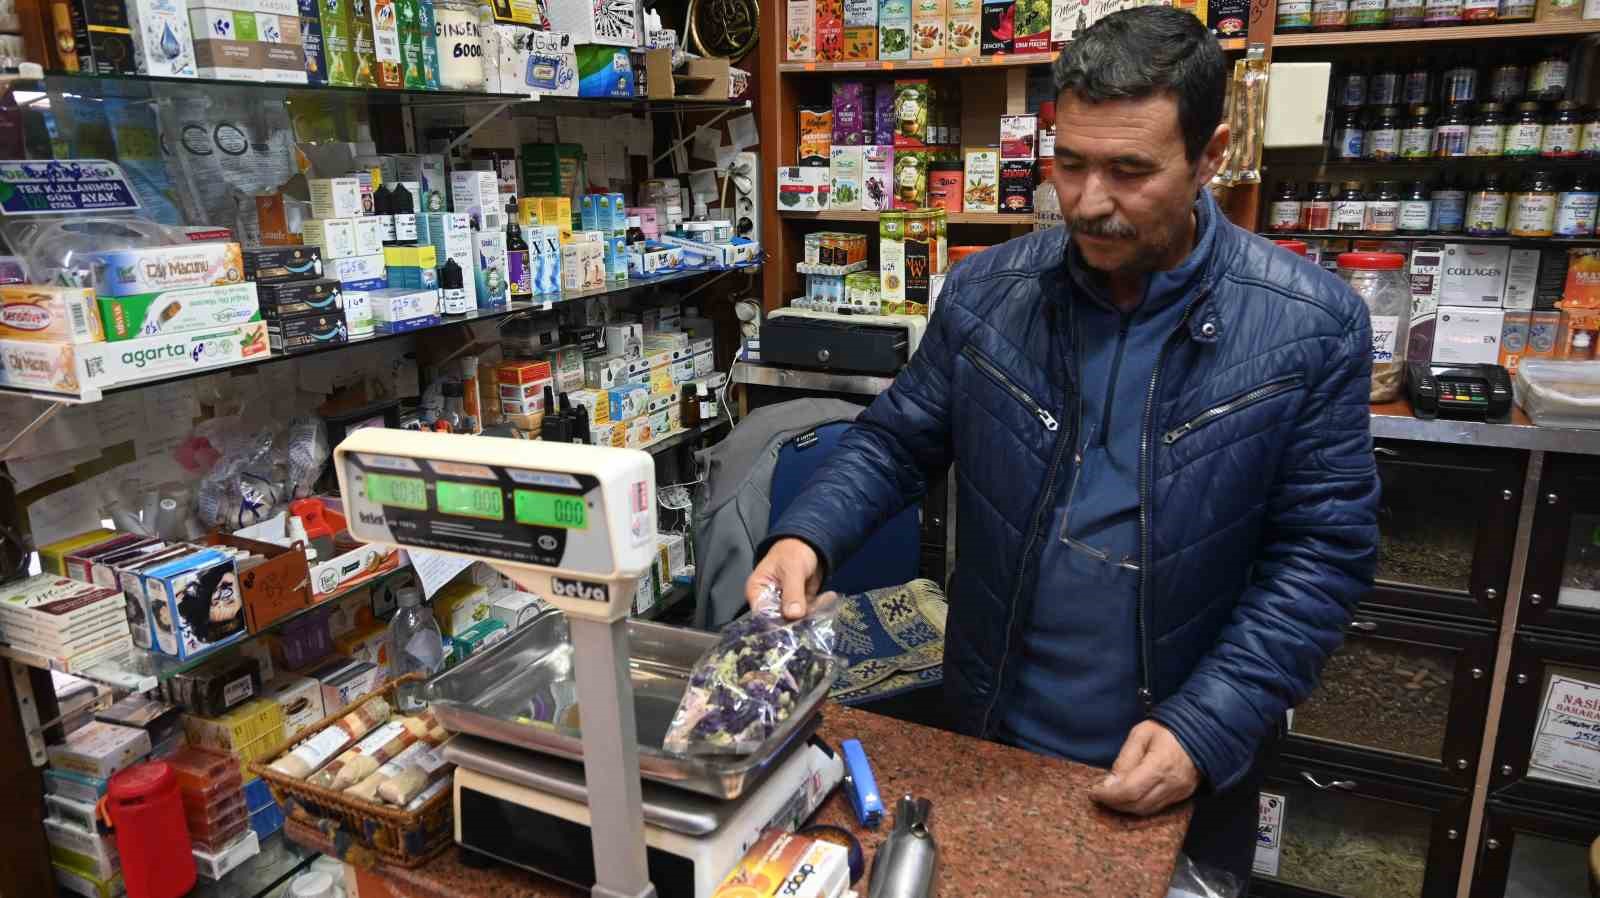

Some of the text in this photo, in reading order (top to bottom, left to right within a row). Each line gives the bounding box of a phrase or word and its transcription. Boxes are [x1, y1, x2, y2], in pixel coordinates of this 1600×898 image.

[17, 185, 43, 193] TEK
[80, 191, 117, 204] AYAK
[1446, 267, 1501, 277] COLLAGEN
[121, 343, 185, 367] agarta
[553, 579, 606, 602] betsa
